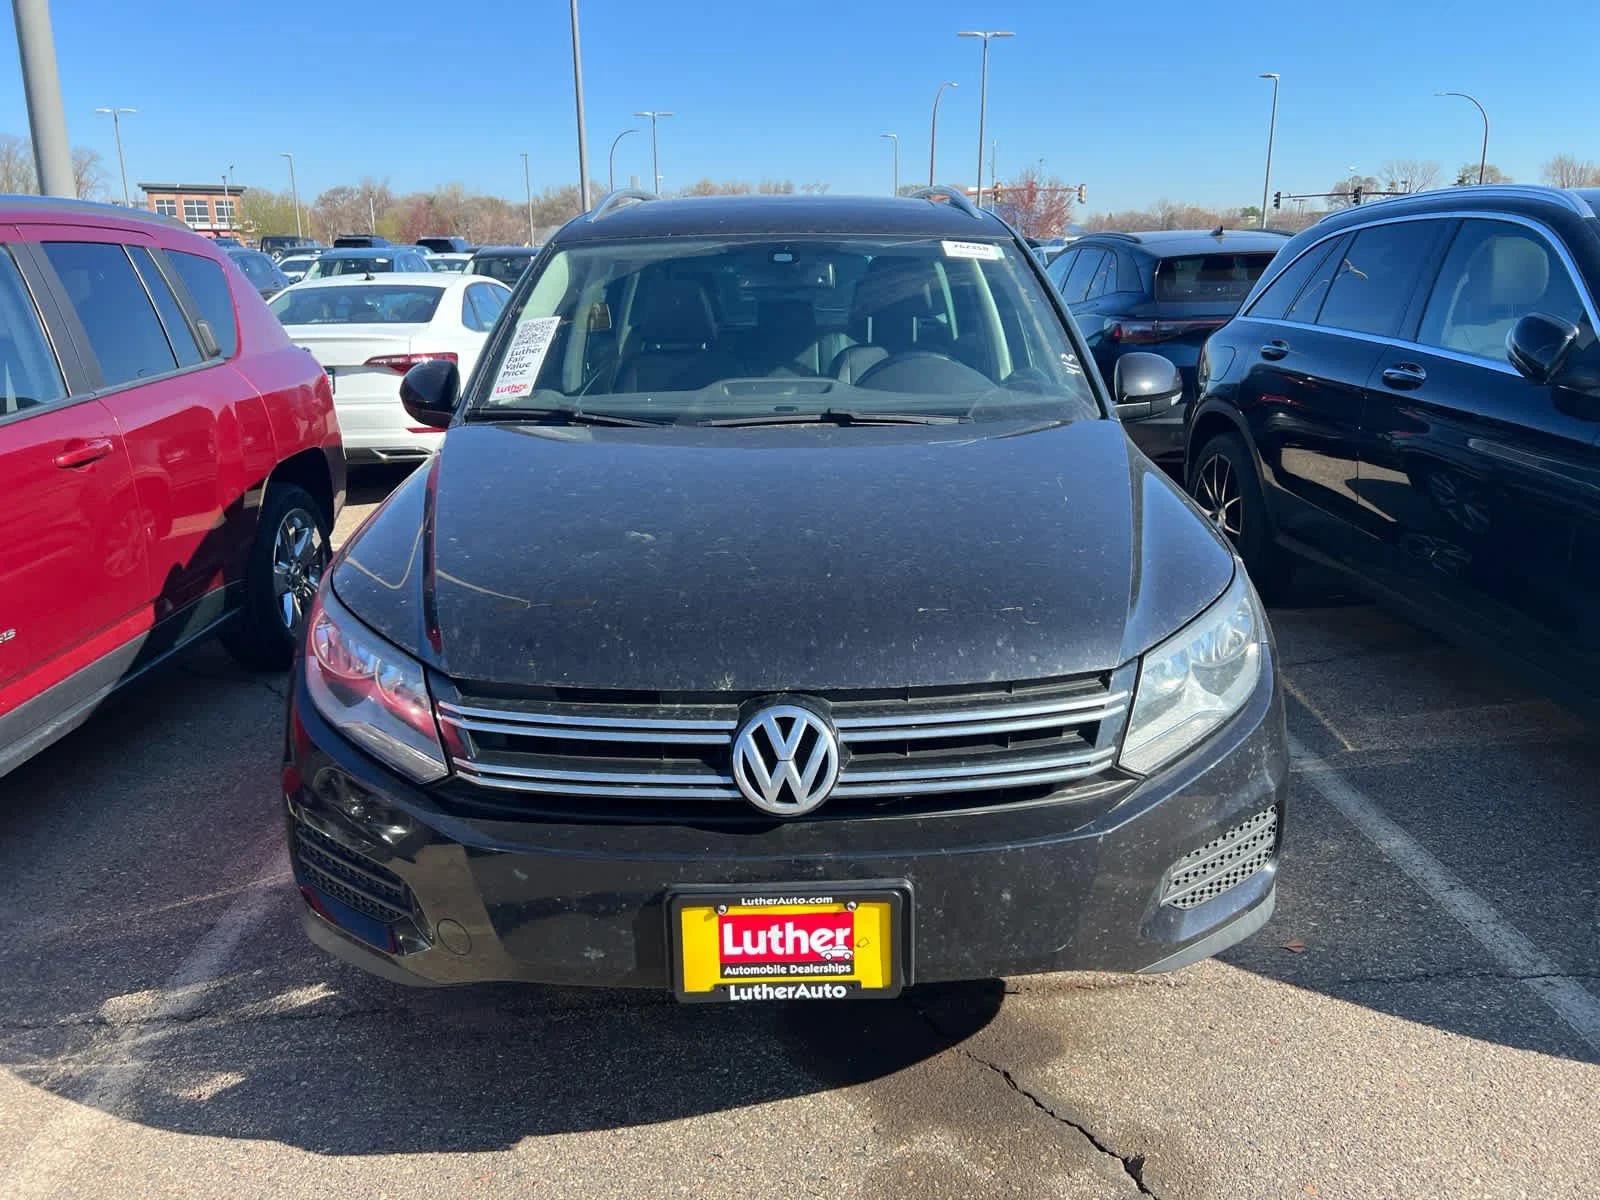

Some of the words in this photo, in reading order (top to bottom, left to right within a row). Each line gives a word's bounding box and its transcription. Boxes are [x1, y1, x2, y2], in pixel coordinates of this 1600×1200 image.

[511, 347, 542, 357] Luther
[508, 356, 525, 364] Fair
[505, 362, 532, 370] Value
[496, 383, 528, 393] Luther
[741, 896, 833, 906] LutherAuto.com
[722, 922, 851, 956] Luther
[724, 964, 787, 975] Automobile
[789, 963, 851, 975] Dealerships
[729, 983, 847, 1001] LutherAuto
